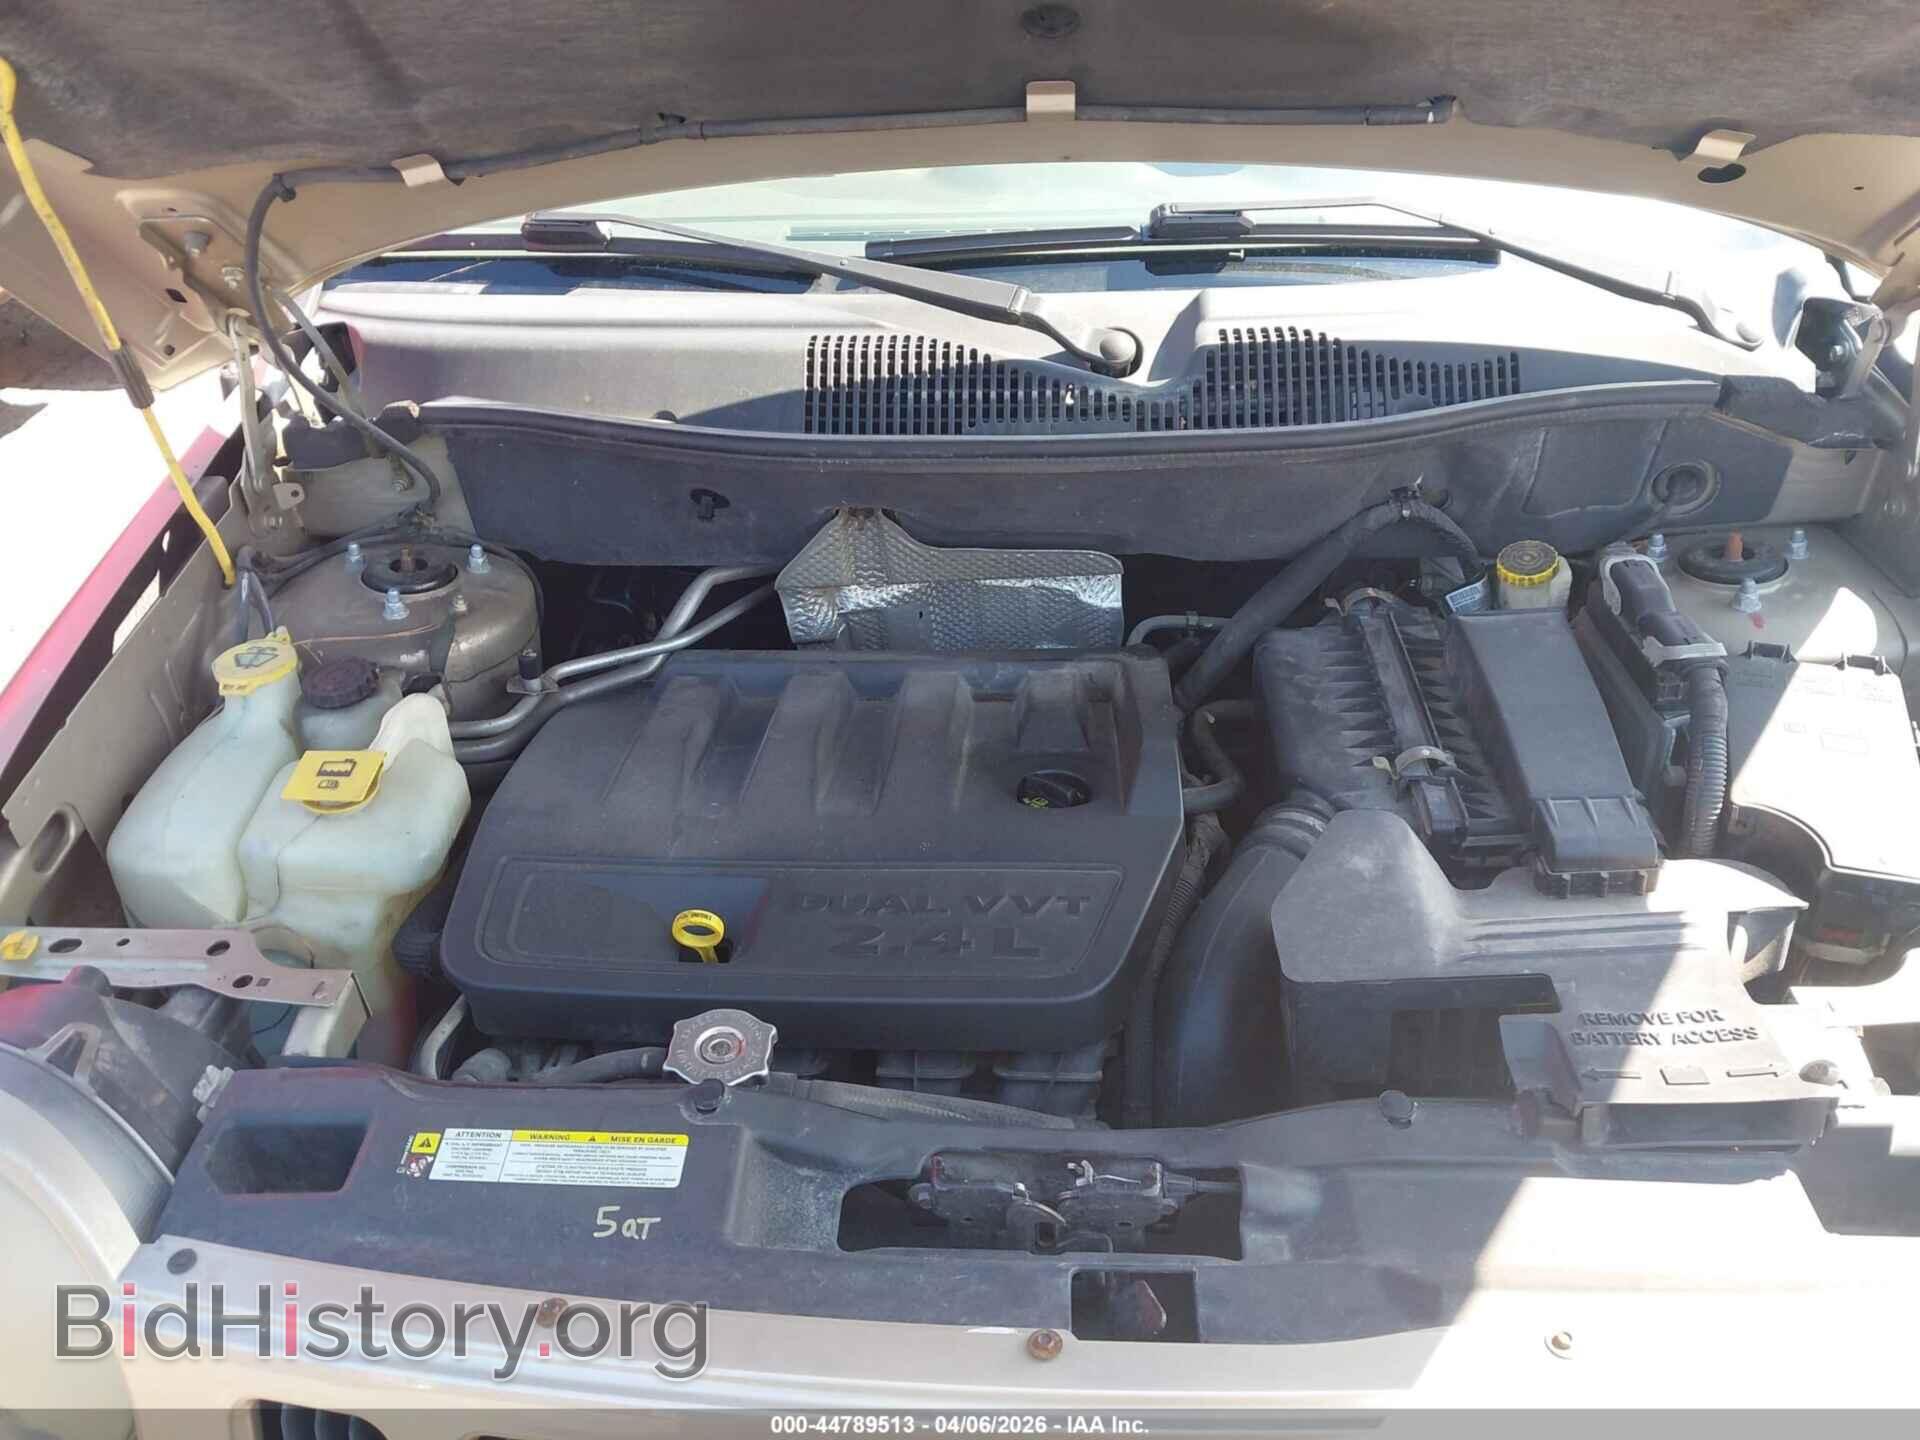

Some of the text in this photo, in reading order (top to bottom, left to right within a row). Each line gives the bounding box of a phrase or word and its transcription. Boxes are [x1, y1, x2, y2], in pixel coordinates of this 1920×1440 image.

[797, 894, 1090, 918] DUAL VVT
[1579, 1009, 1725, 1026] REMOVE FOR
[1569, 1026, 1759, 1046] BATTERY ACCESS
[529, 1133, 570, 1141] WARNING
[610, 1135, 630, 1143] MISE
[648, 1136, 677, 1144] GARDE
